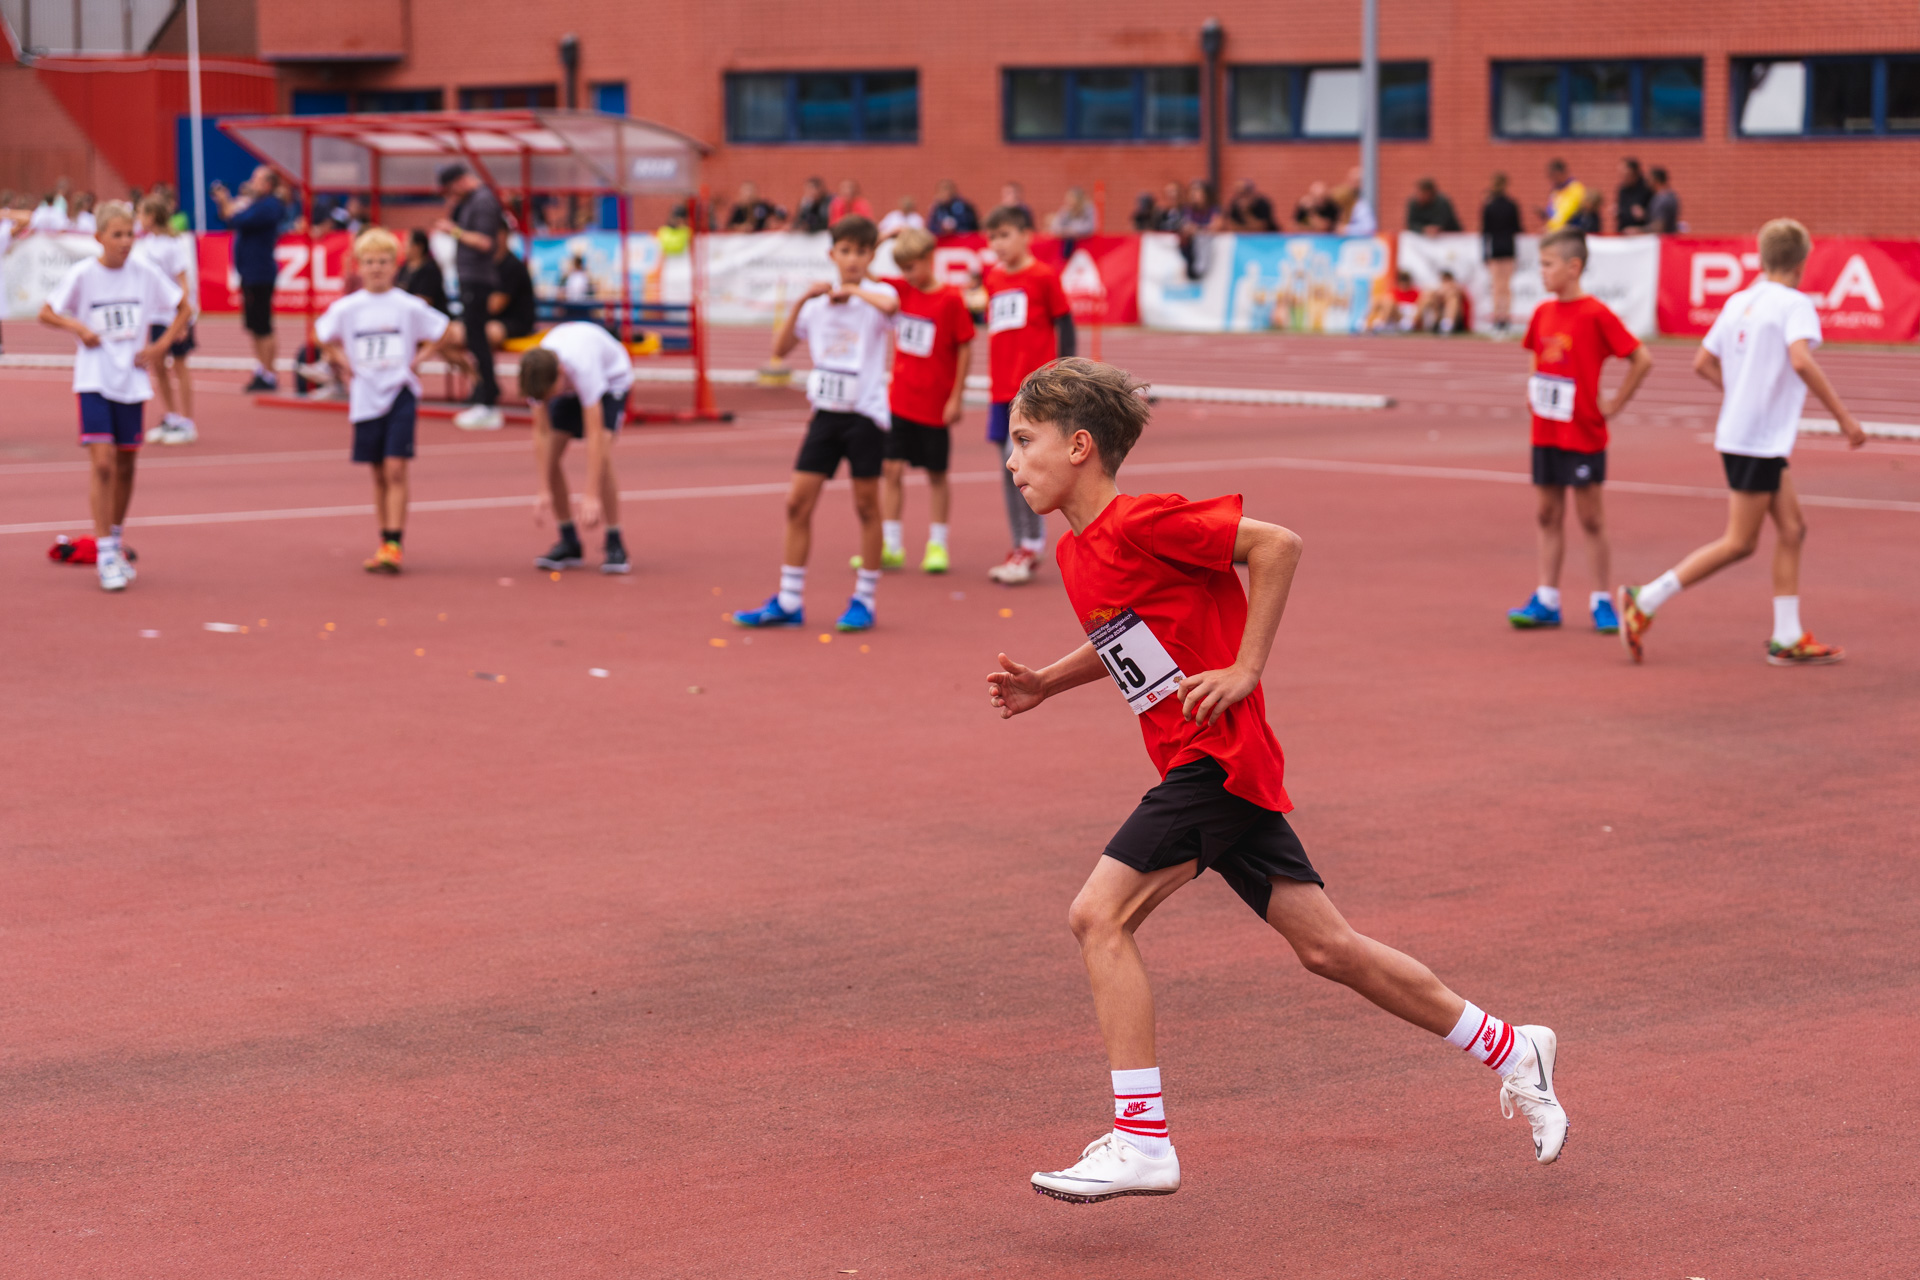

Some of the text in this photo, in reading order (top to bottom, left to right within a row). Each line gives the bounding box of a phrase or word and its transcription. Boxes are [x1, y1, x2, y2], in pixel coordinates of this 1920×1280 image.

[228, 244, 344, 291] ZL
[1689, 251, 1885, 311] PA
[1481, 1025, 1495, 1045] NIKE
[1127, 1101, 1147, 1111] NIKE
